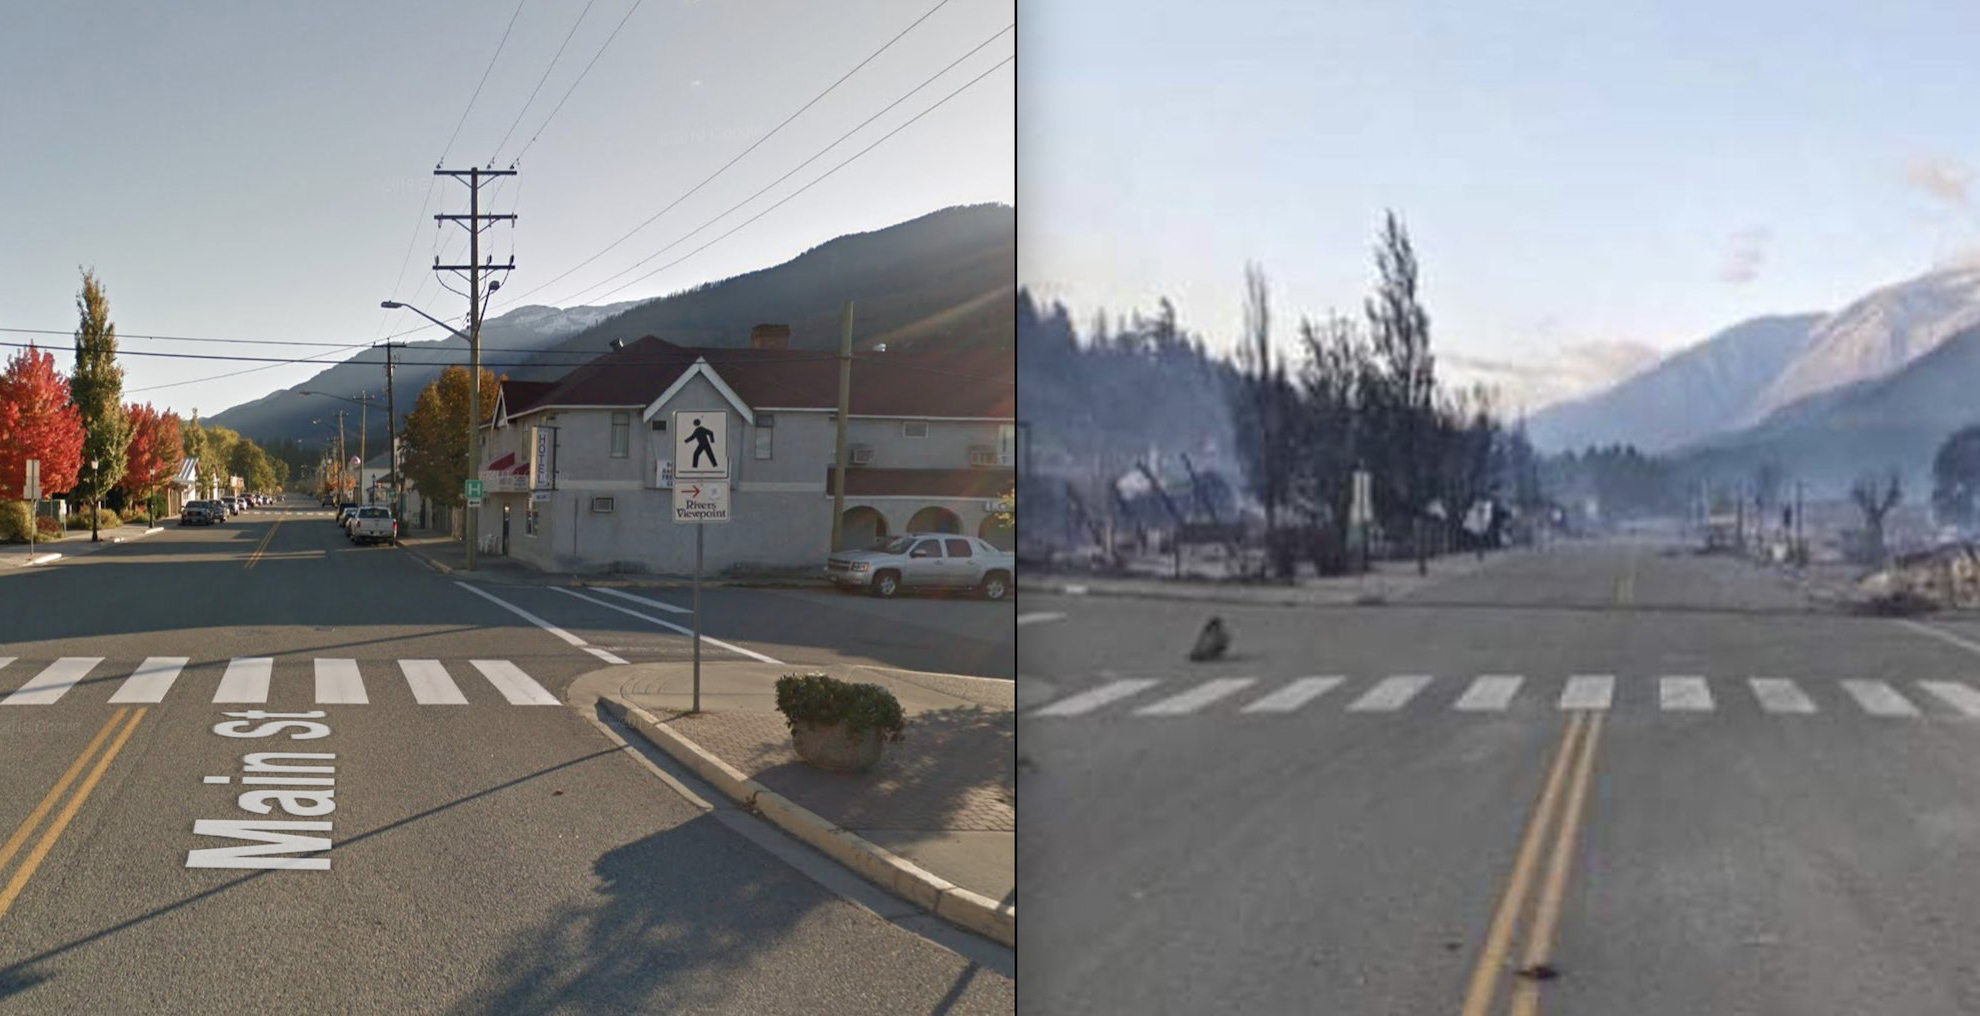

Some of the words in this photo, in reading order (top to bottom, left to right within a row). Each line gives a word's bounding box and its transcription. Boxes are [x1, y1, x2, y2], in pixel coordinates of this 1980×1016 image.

[537, 434, 546, 484] HOTEL
[468, 483, 481, 495] H
[686, 499, 717, 510] Rivers
[676, 508, 726, 518] Viewpoint
